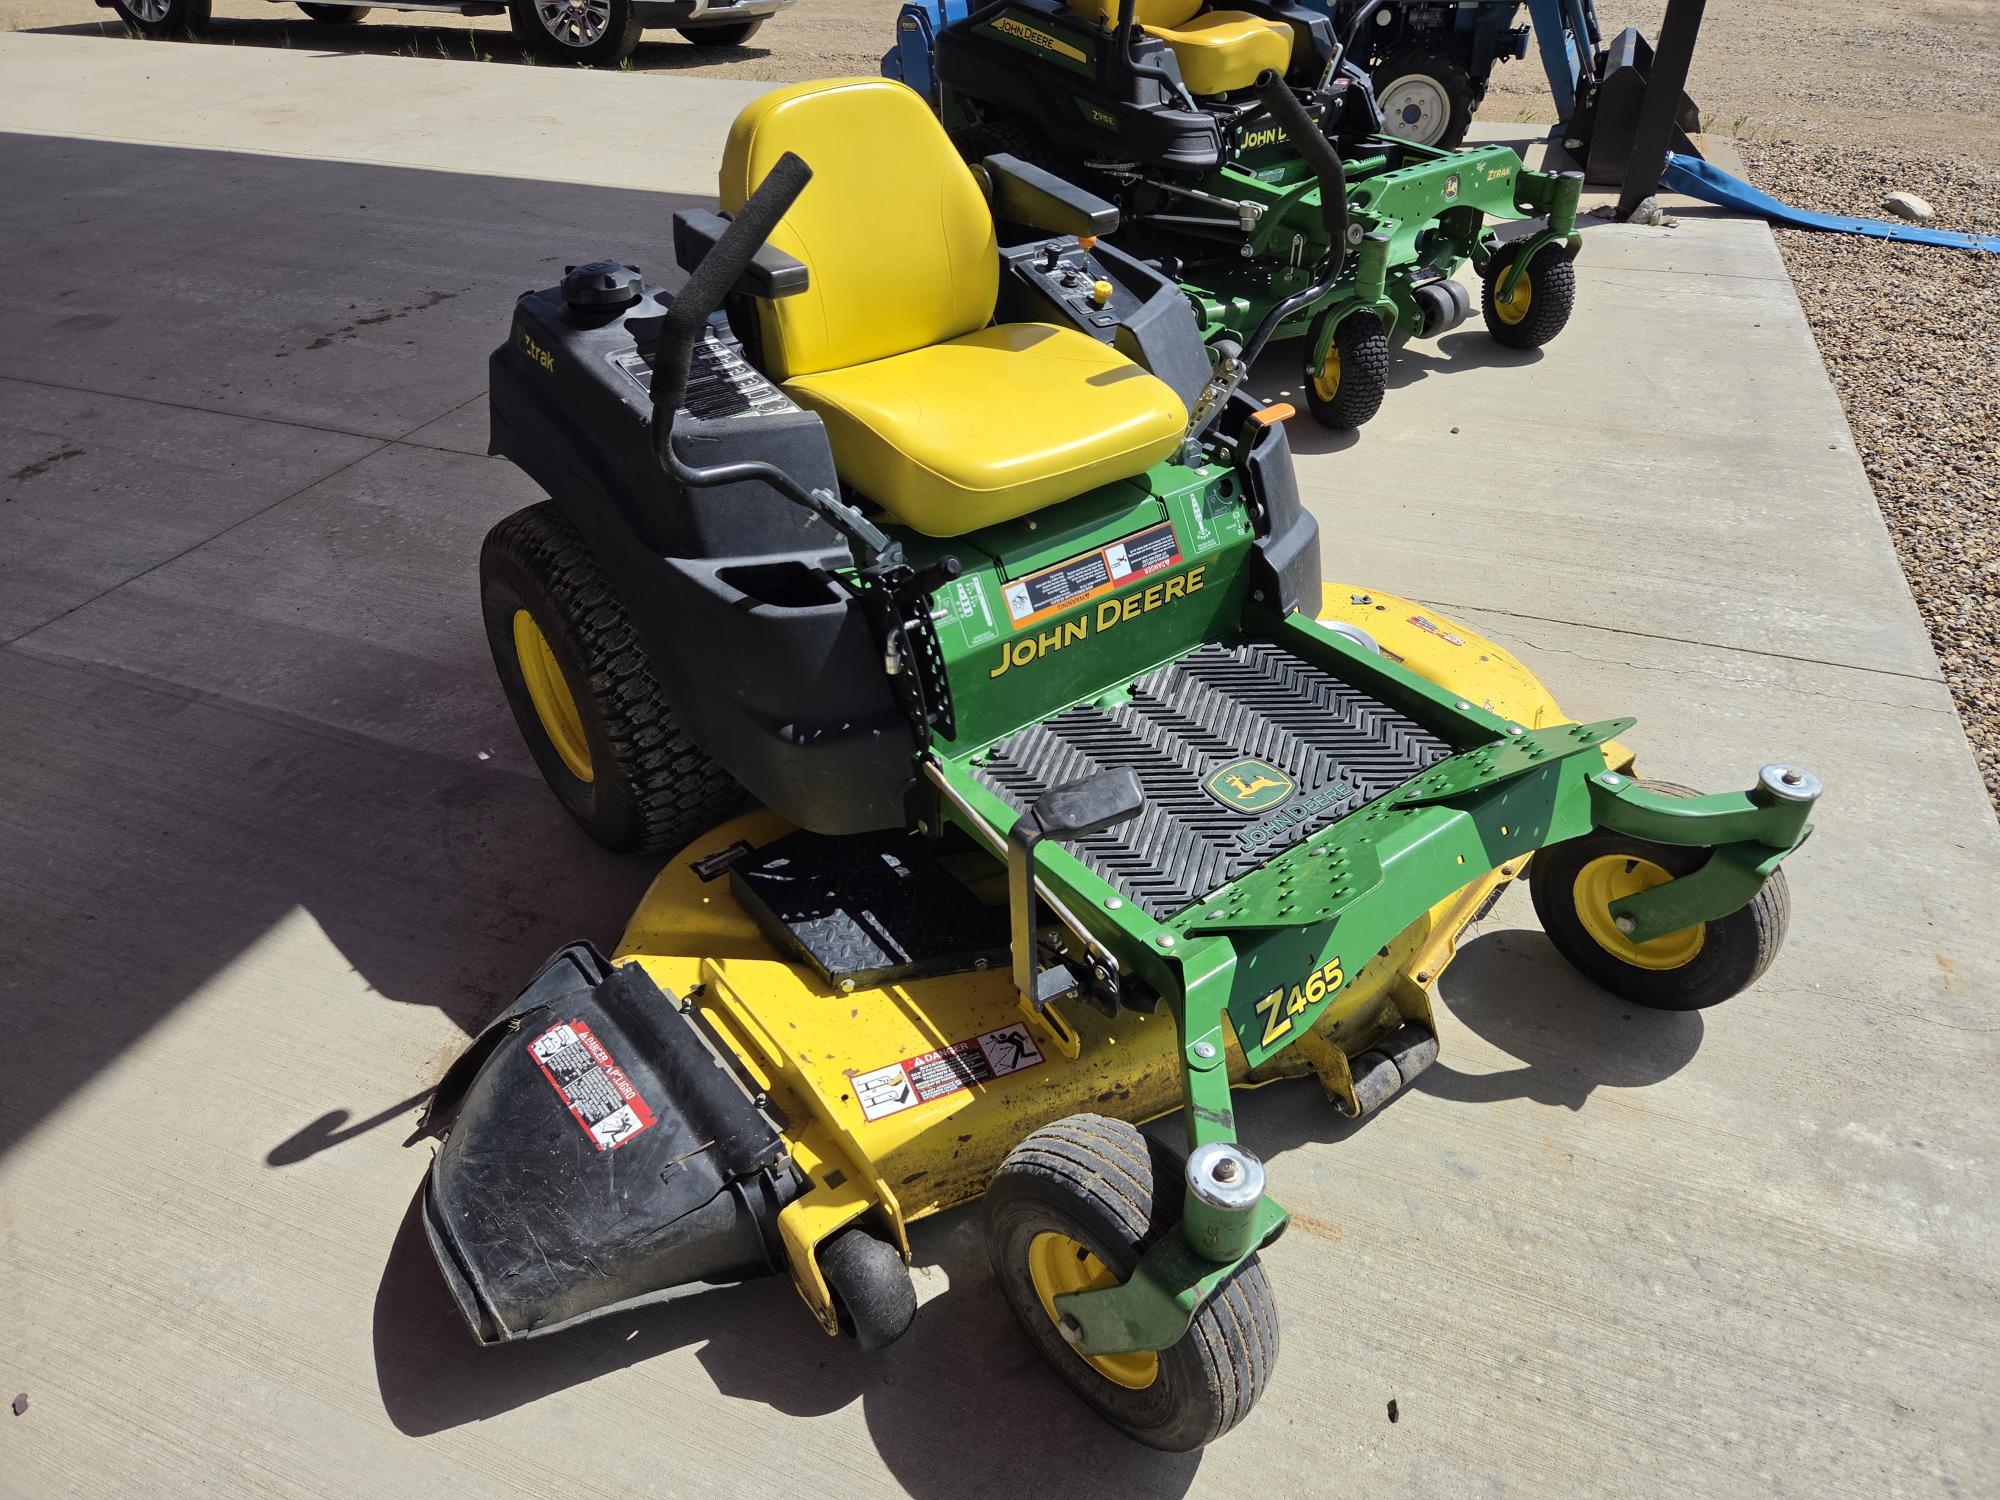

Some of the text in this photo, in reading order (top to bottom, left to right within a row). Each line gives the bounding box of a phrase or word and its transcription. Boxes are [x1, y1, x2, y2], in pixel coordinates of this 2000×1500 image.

[999, 20, 1054, 49] JOHN DEERE
[1240, 127, 1276, 150] JOHN
[1144, 559, 1166, 575] DANGER
[1058, 593, 1086, 610] WARNING
[989, 614, 1089, 680] JOHN
[1096, 563, 1207, 633] DEERE
[1239, 783, 1355, 852] JOHN DEERE
[1255, 956, 1344, 1052] Z465
[584, 1037, 608, 1063] DANGER
[924, 1043, 968, 1062] DANGER
[609, 1069, 636, 1100] PELIGRO
